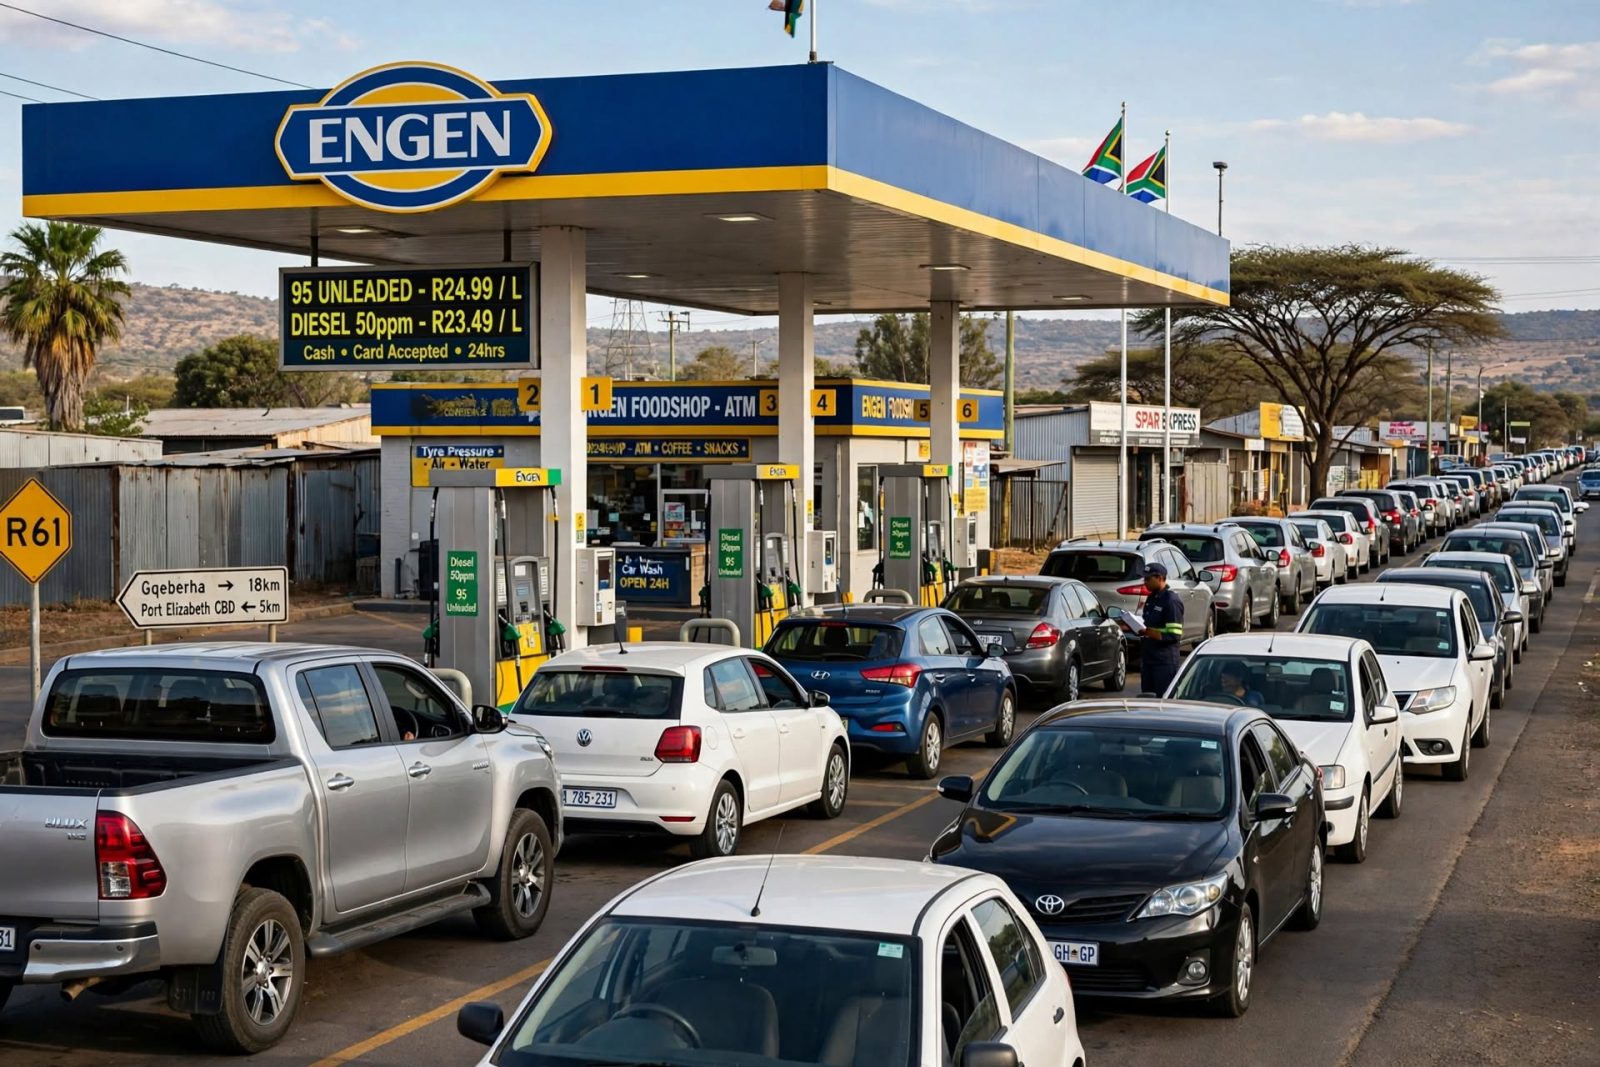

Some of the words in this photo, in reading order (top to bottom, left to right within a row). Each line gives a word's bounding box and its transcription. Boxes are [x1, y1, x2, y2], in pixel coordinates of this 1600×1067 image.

[309, 110, 511, 165] ENGEN
[291, 281, 313, 304] 95
[318, 278, 413, 304] UNLEADED
[431, 276, 493, 301] R24.99
[512, 276, 522, 300] L
[291, 311, 351, 336] DIESEL
[355, 311, 413, 340] 50ppm
[431, 309, 493, 334] R23.49
[512, 308, 522, 333] L
[303, 344, 335, 360] Cash
[353, 344, 384, 359] Card
[387, 343, 449, 362] Accepted
[468, 343, 505, 358] 24hrs
[526, 384, 539, 405] 2
[590, 384, 599, 405] 1
[767, 394, 777, 411] 3
[817, 394, 828, 411] 4
[631, 395, 711, 418] FOODSHOP
[724, 395, 756, 418] ATM
[920, 403, 928, 418] 5
[962, 403, 972, 418] 6
[1135, 410, 1160, 429] SPAR
[421, 446, 445, 458] Tyre
[447, 446, 495, 457] Pressure
[661, 442, 693, 455] COFFEE
[703, 442, 739, 455] SNACKS
[431, 457, 445, 469] Air
[459, 457, 490, 469] Water
[7, 516, 61, 547] R61
[450, 556, 474, 567] Diesel
[621, 564, 637, 574] Car
[639, 562, 663, 575] Wash
[725, 557, 735, 567] 95
[450, 570, 475, 584] 50ppm
[620, 577, 647, 589] OPEN
[649, 577, 669, 589] 24H
[141, 579, 206, 599] Gqeberha
[248, 577, 280, 592] 18km
[456, 588, 467, 600] 95
[141, 602, 163, 617] Port
[166, 601, 211, 617] Elizabeth
[214, 600, 236, 615] CBD
[259, 600, 280, 614] 5km
[1079, 945, 1095, 963] GP
